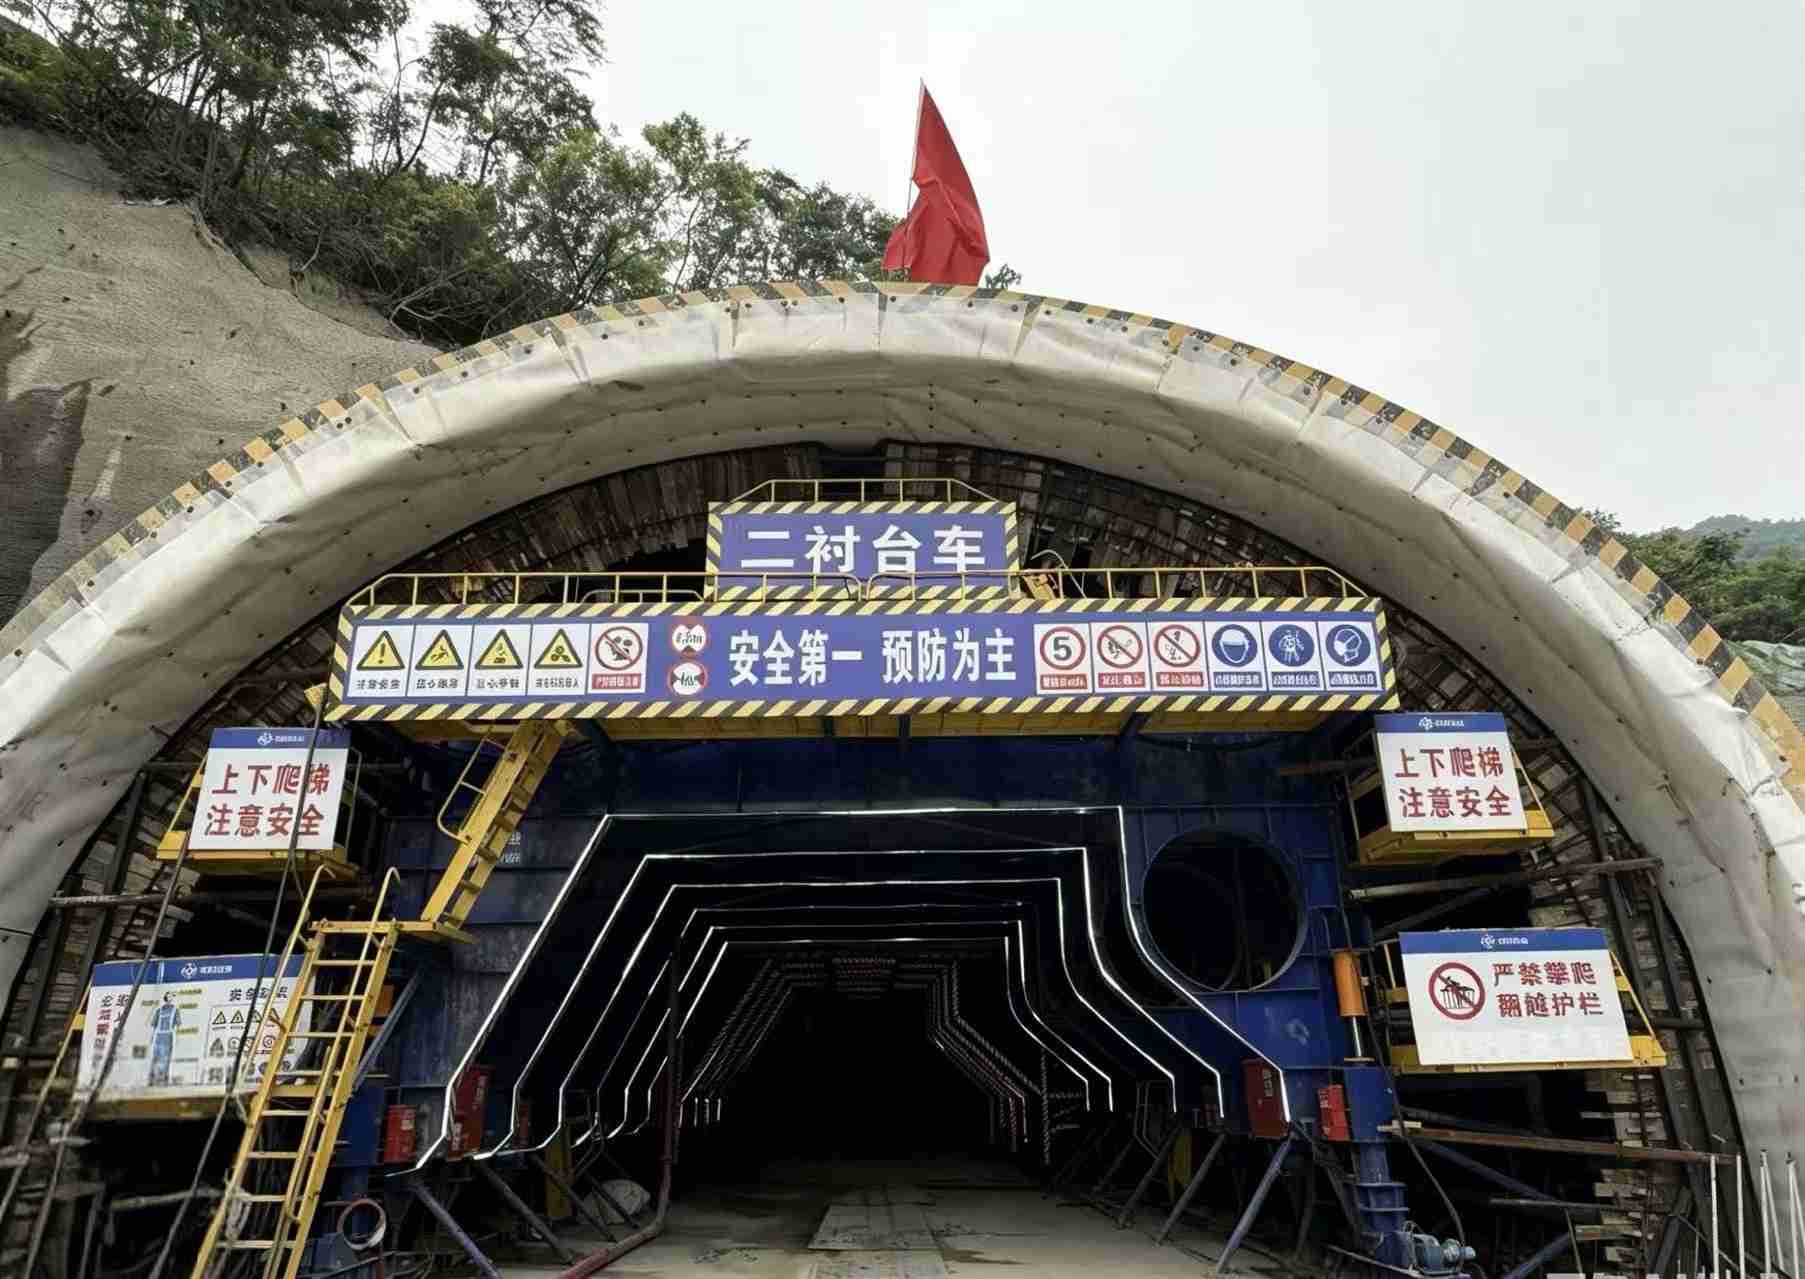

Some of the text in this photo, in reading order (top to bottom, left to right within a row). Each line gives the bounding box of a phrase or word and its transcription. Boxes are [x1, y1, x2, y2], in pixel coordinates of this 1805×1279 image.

[741, 524, 986, 574] 二衬台车
[728, 627, 1017, 687] 安全第一 预防为主
[1052, 635, 1073, 661] 5
[1395, 746, 1504, 778] 上下爬梯
[211, 763, 332, 795] 上下爬梯
[1398, 785, 1513, 818] 注意安全
[204, 803, 325, 837] 注意安全
